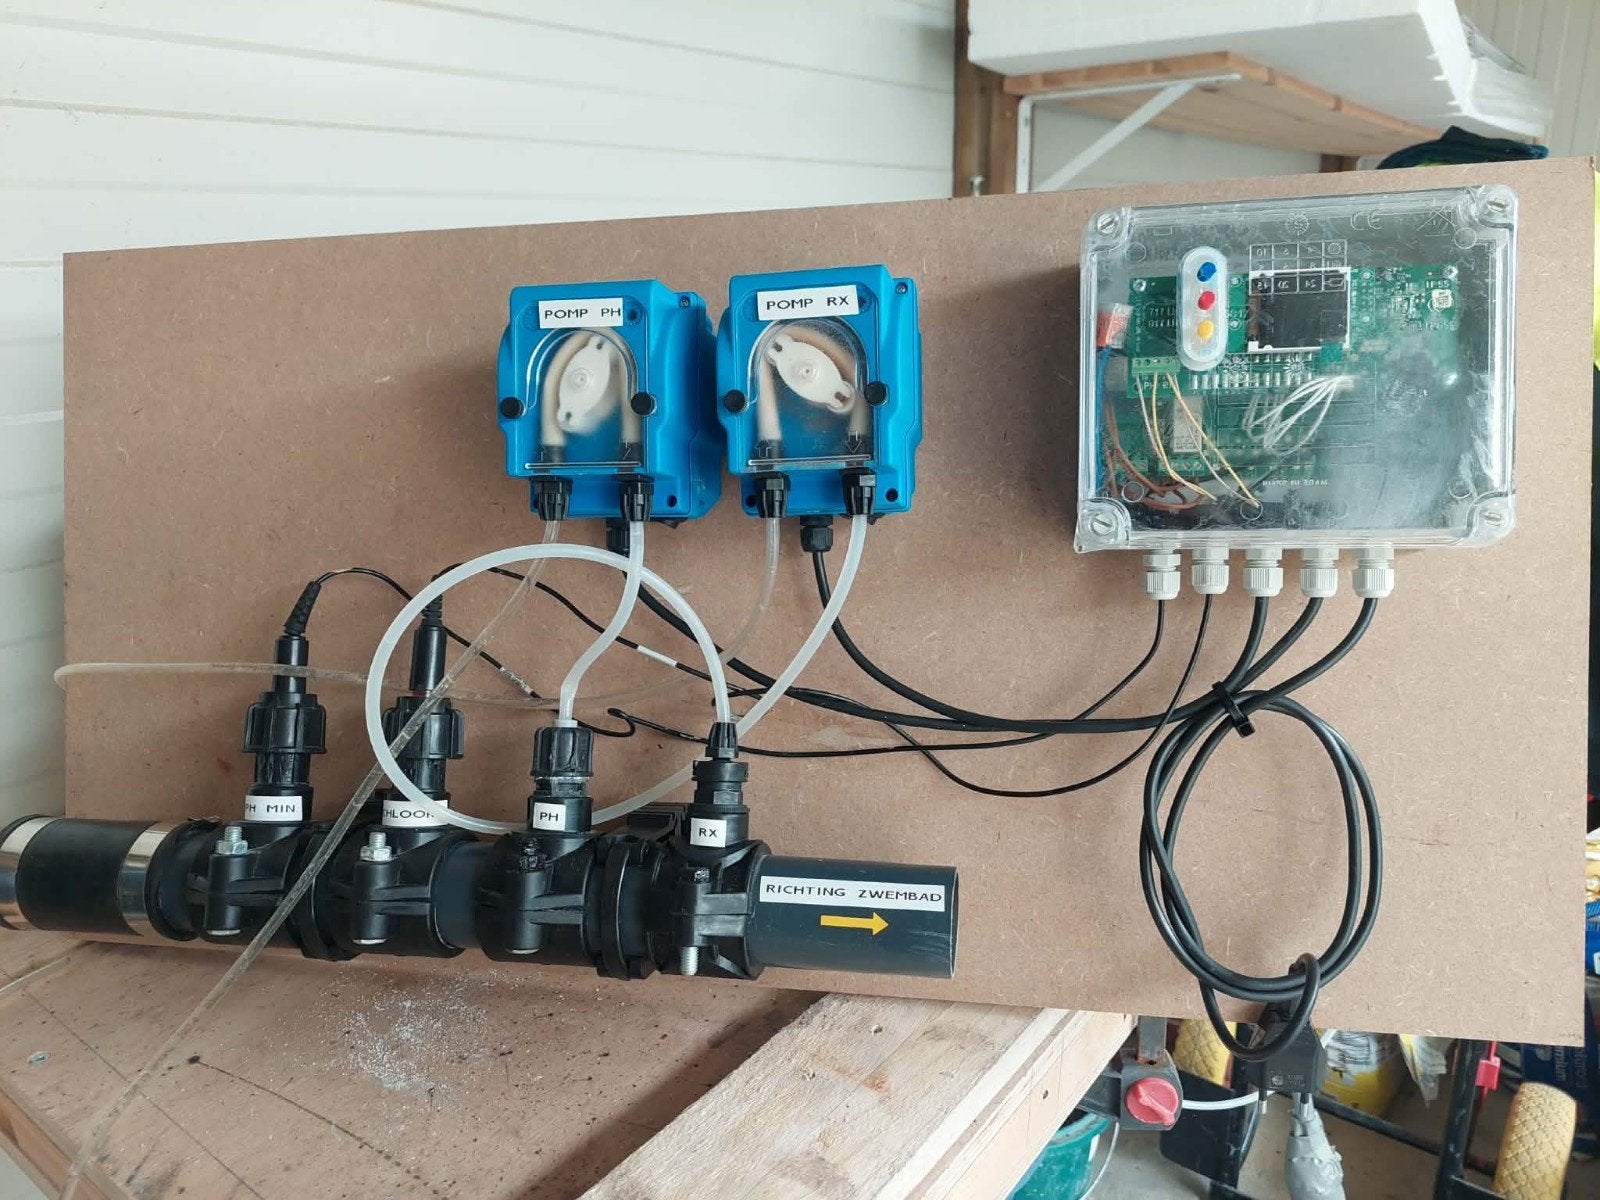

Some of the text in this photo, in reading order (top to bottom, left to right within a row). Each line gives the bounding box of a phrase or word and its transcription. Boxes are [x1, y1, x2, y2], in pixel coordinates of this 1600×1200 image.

[766, 295, 850, 311] POMP RX
[544, 307, 622, 320] POMP PH
[266, 804, 296, 814] MIN
[540, 811, 559, 822] PH
[698, 827, 718, 838] RX
[766, 884, 942, 902] RICHTING ZWEMBAD
